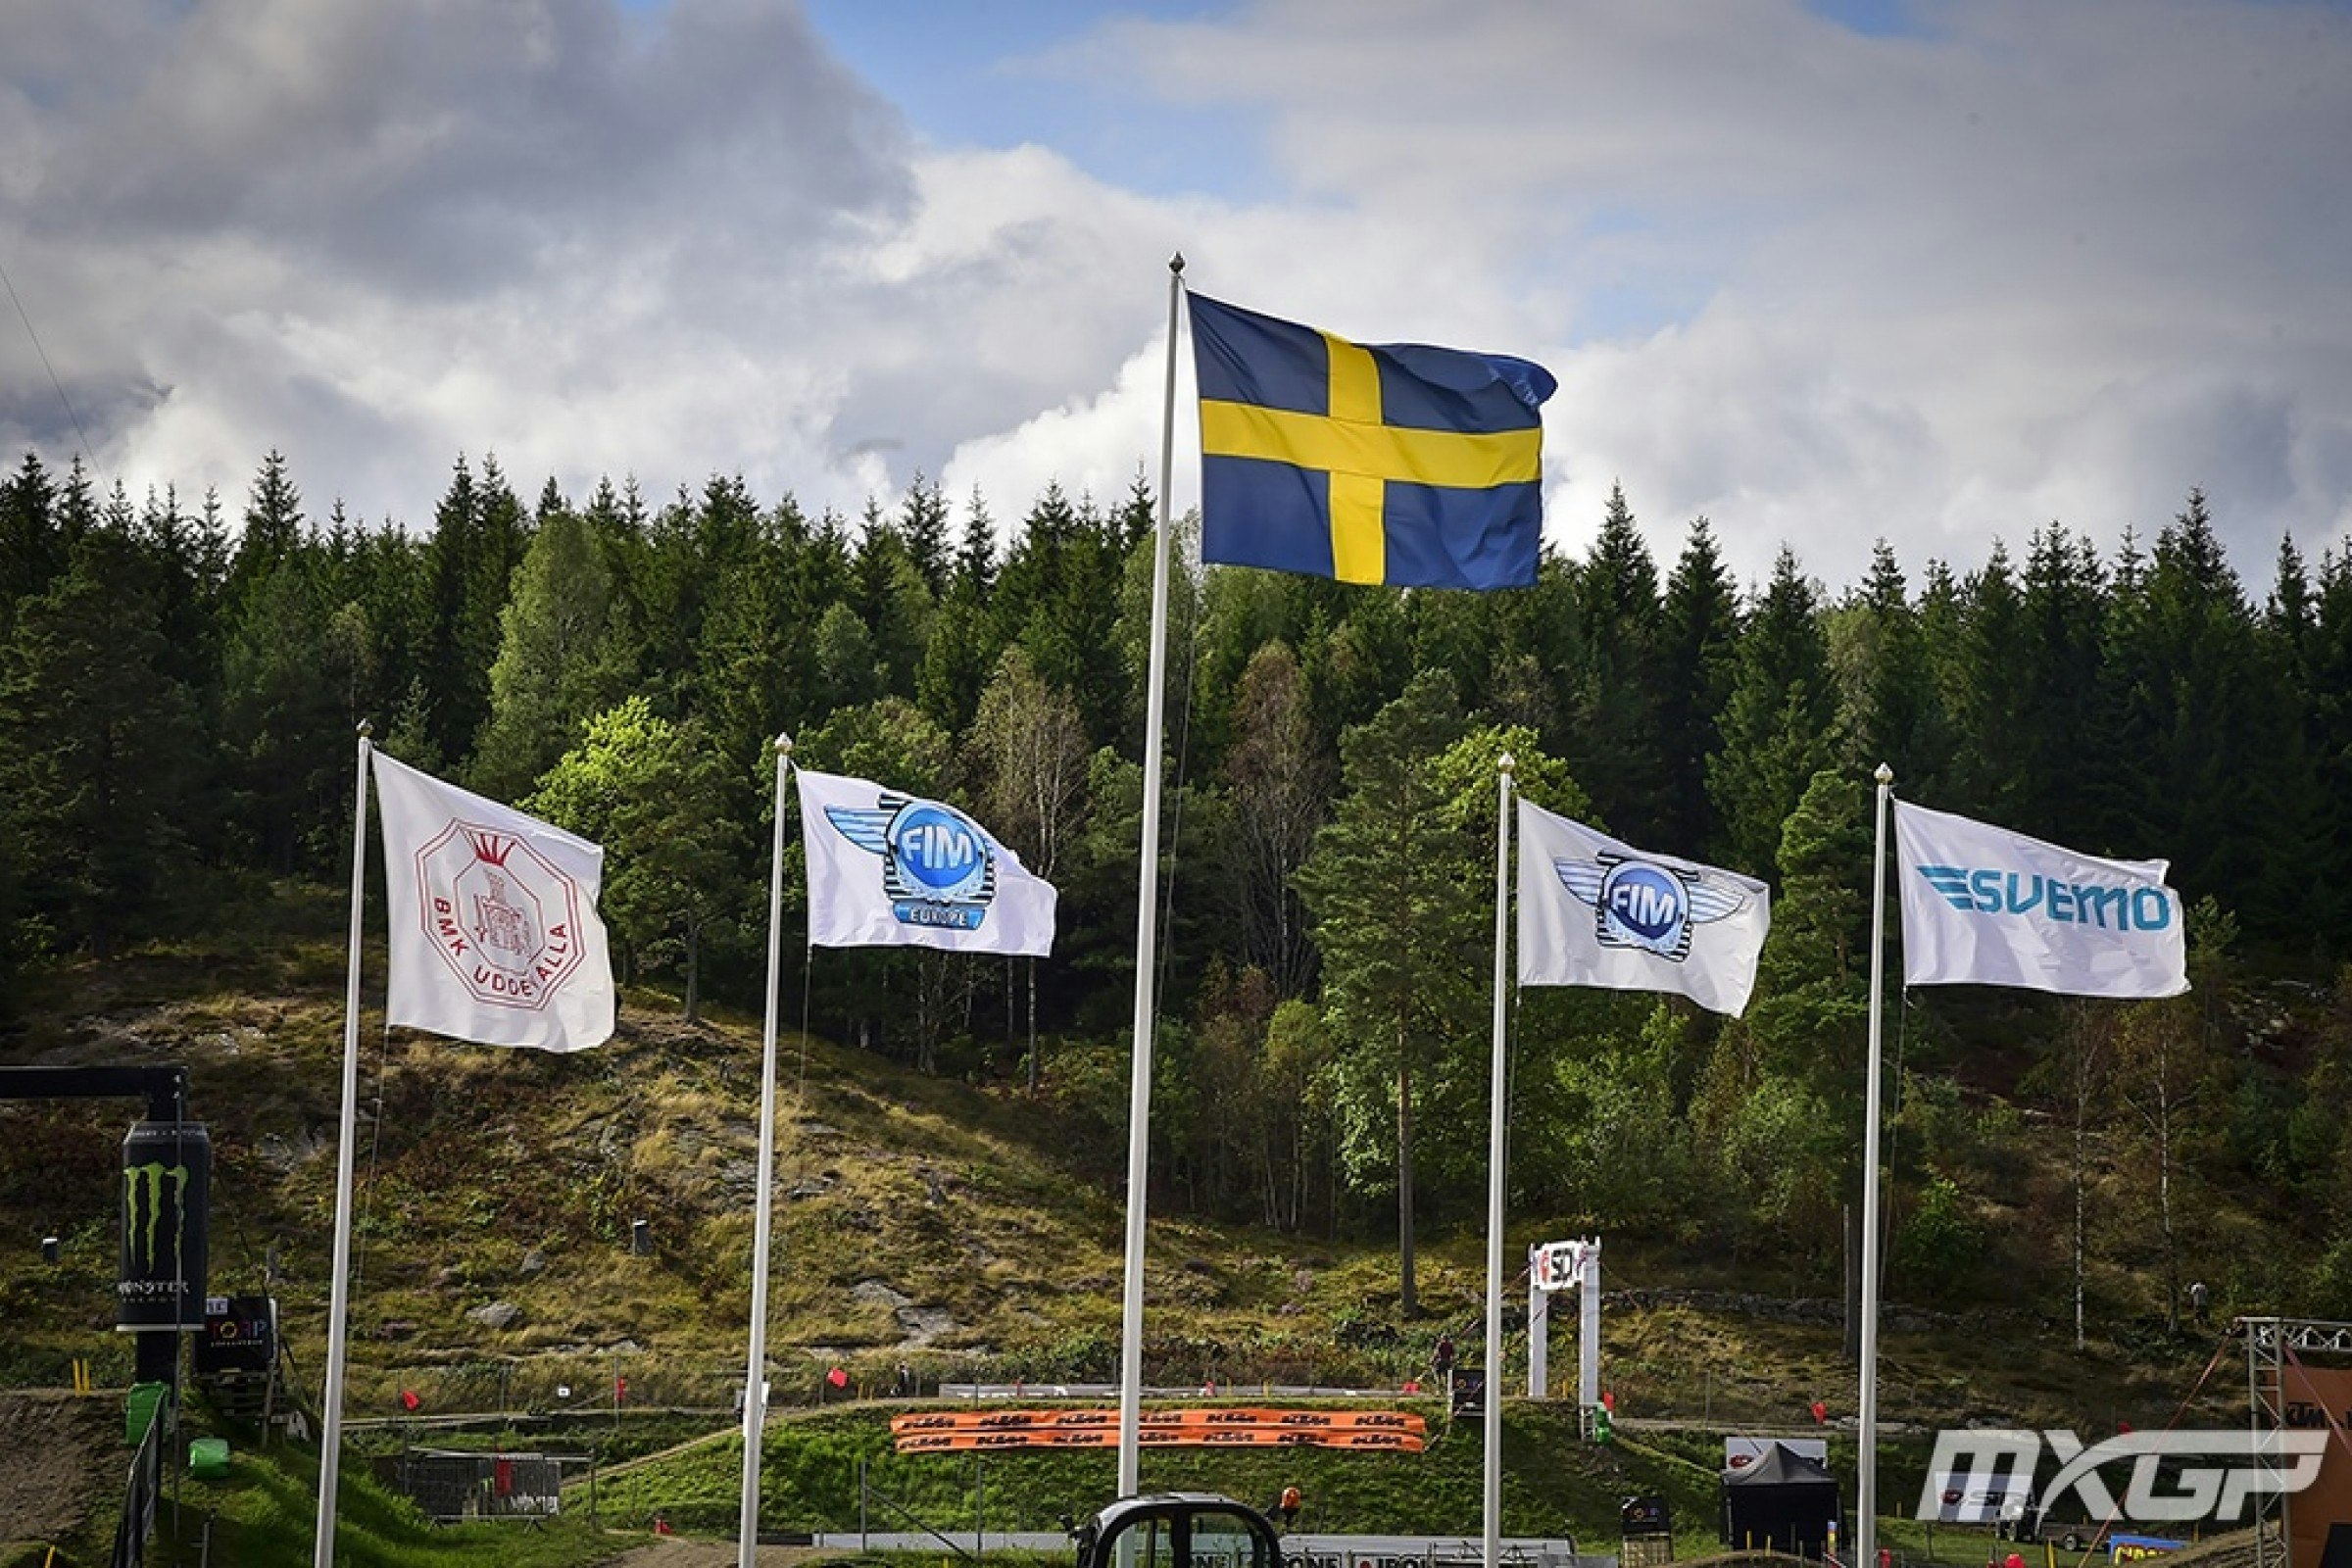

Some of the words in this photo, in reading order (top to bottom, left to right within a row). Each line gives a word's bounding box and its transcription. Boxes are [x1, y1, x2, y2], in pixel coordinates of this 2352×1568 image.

[902, 824, 974, 870] FIM
[910, 905, 968, 926] EUROPE
[1611, 882, 1677, 927] FIM
[1970, 868, 2171, 931] SVEMO
[433, 896, 470, 957] BMK
